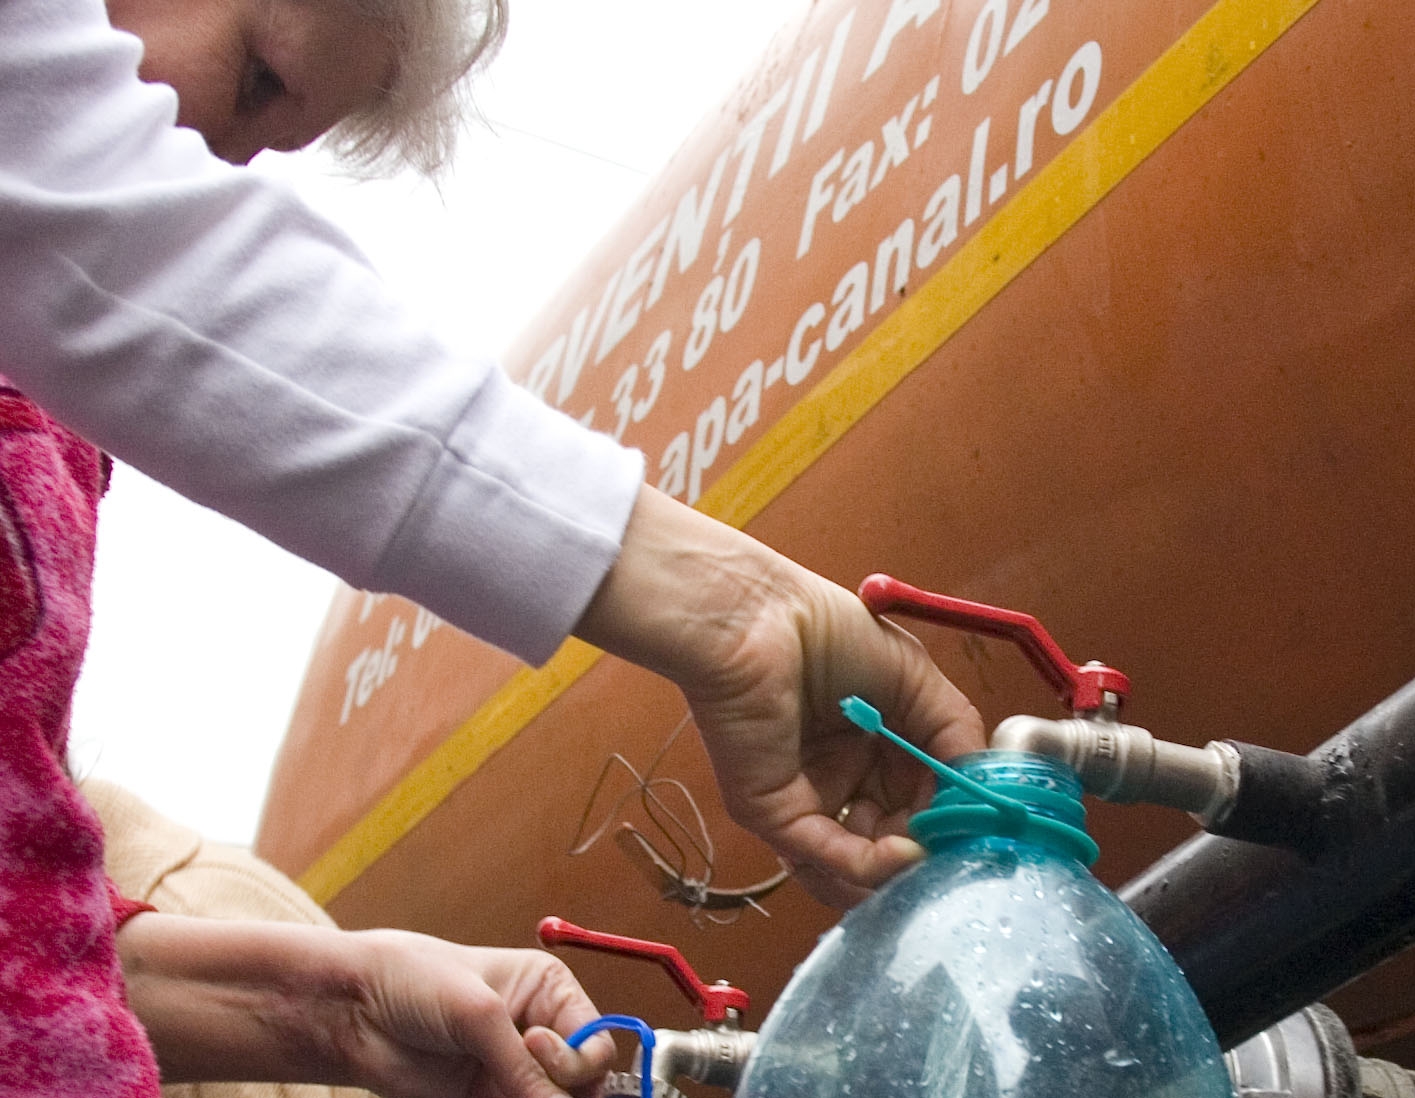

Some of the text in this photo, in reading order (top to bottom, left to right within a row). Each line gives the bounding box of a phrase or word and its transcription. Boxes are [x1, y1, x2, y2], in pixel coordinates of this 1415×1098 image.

[339, 615, 407, 726] Tel:
[682, 237, 762, 372] 80
[796, 73, 941, 260] Fax:
